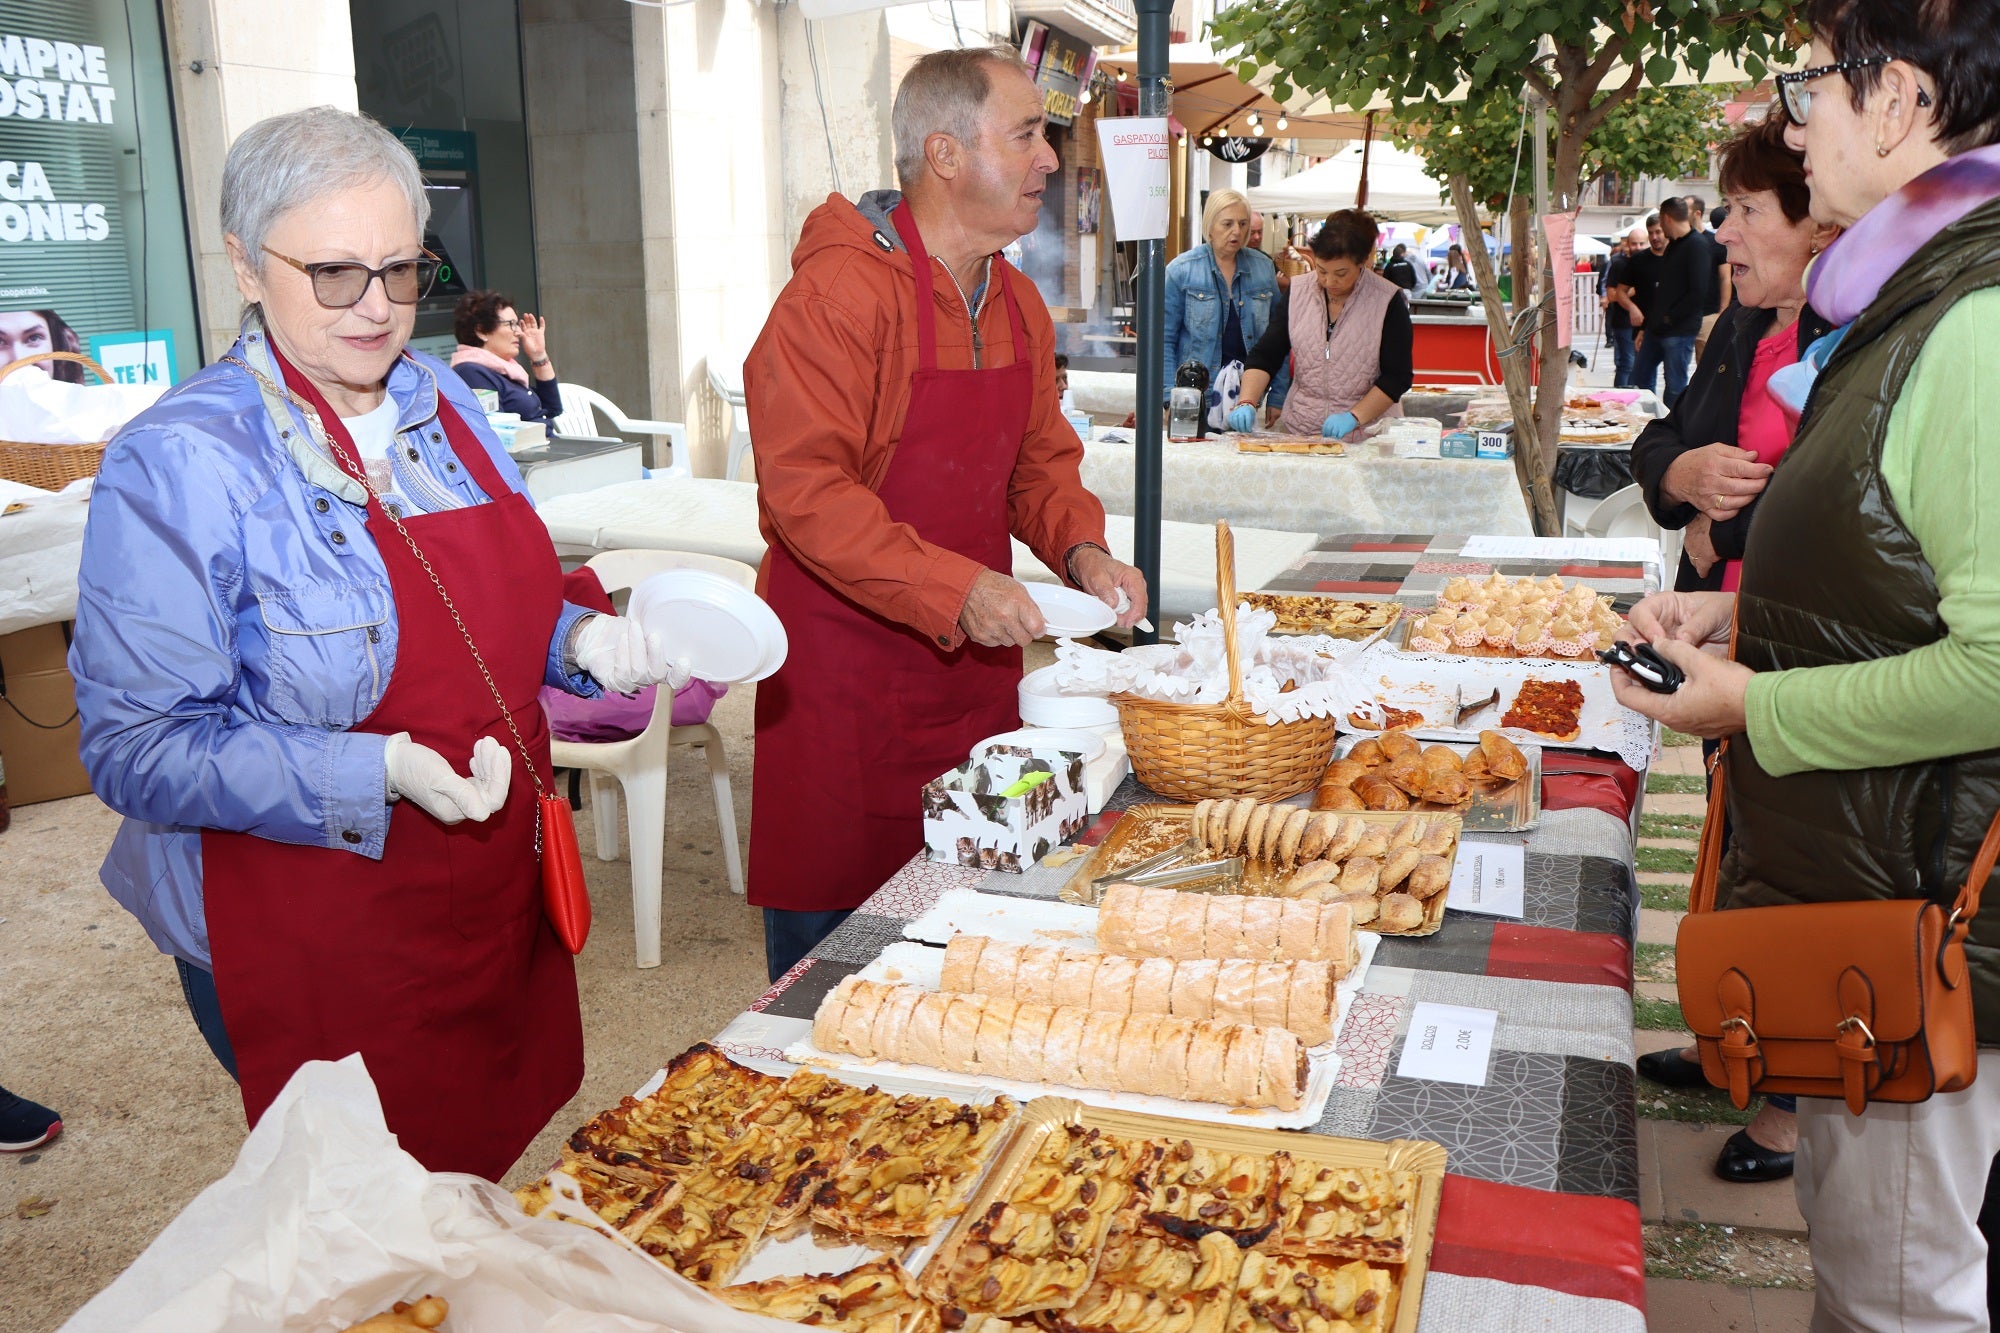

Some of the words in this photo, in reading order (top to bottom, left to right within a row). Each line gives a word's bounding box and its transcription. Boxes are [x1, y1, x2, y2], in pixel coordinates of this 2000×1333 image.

[1062, 49, 1076, 76] EL
[1113, 133, 1160, 145] GASPATXO
[0, 161, 56, 200] CA
[0, 202, 109, 242] ONES
[1482, 436, 1502, 447] 300
[1456, 1029, 1472, 1050] 2,00€
